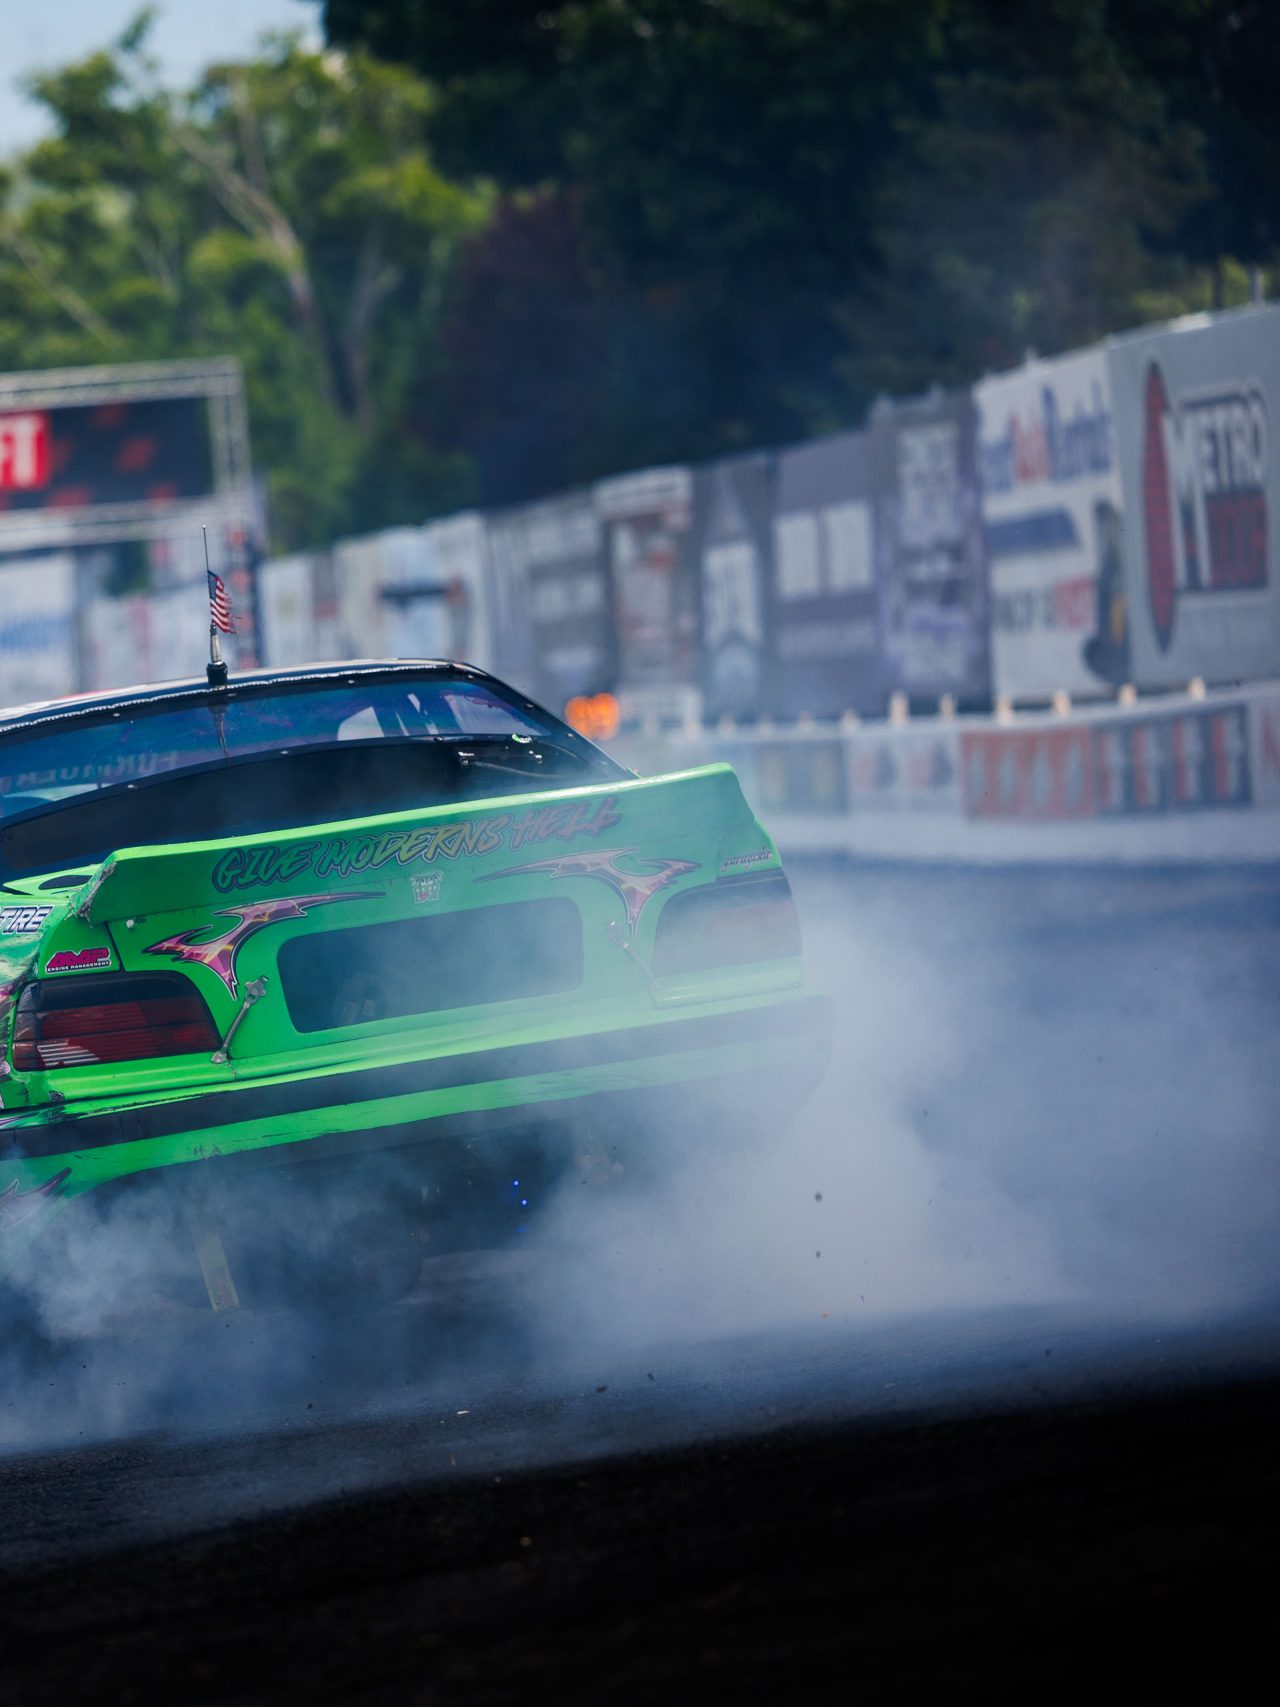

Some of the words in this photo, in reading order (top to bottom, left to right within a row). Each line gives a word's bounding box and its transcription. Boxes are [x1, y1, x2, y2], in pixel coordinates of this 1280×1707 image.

[214, 842, 322, 892] GIVE
[316, 813, 517, 878] MODERNS
[513, 796, 623, 851] HELL
[47, 965, 69, 973] ENGINE
[70, 960, 110, 971] MANAGEMENT
